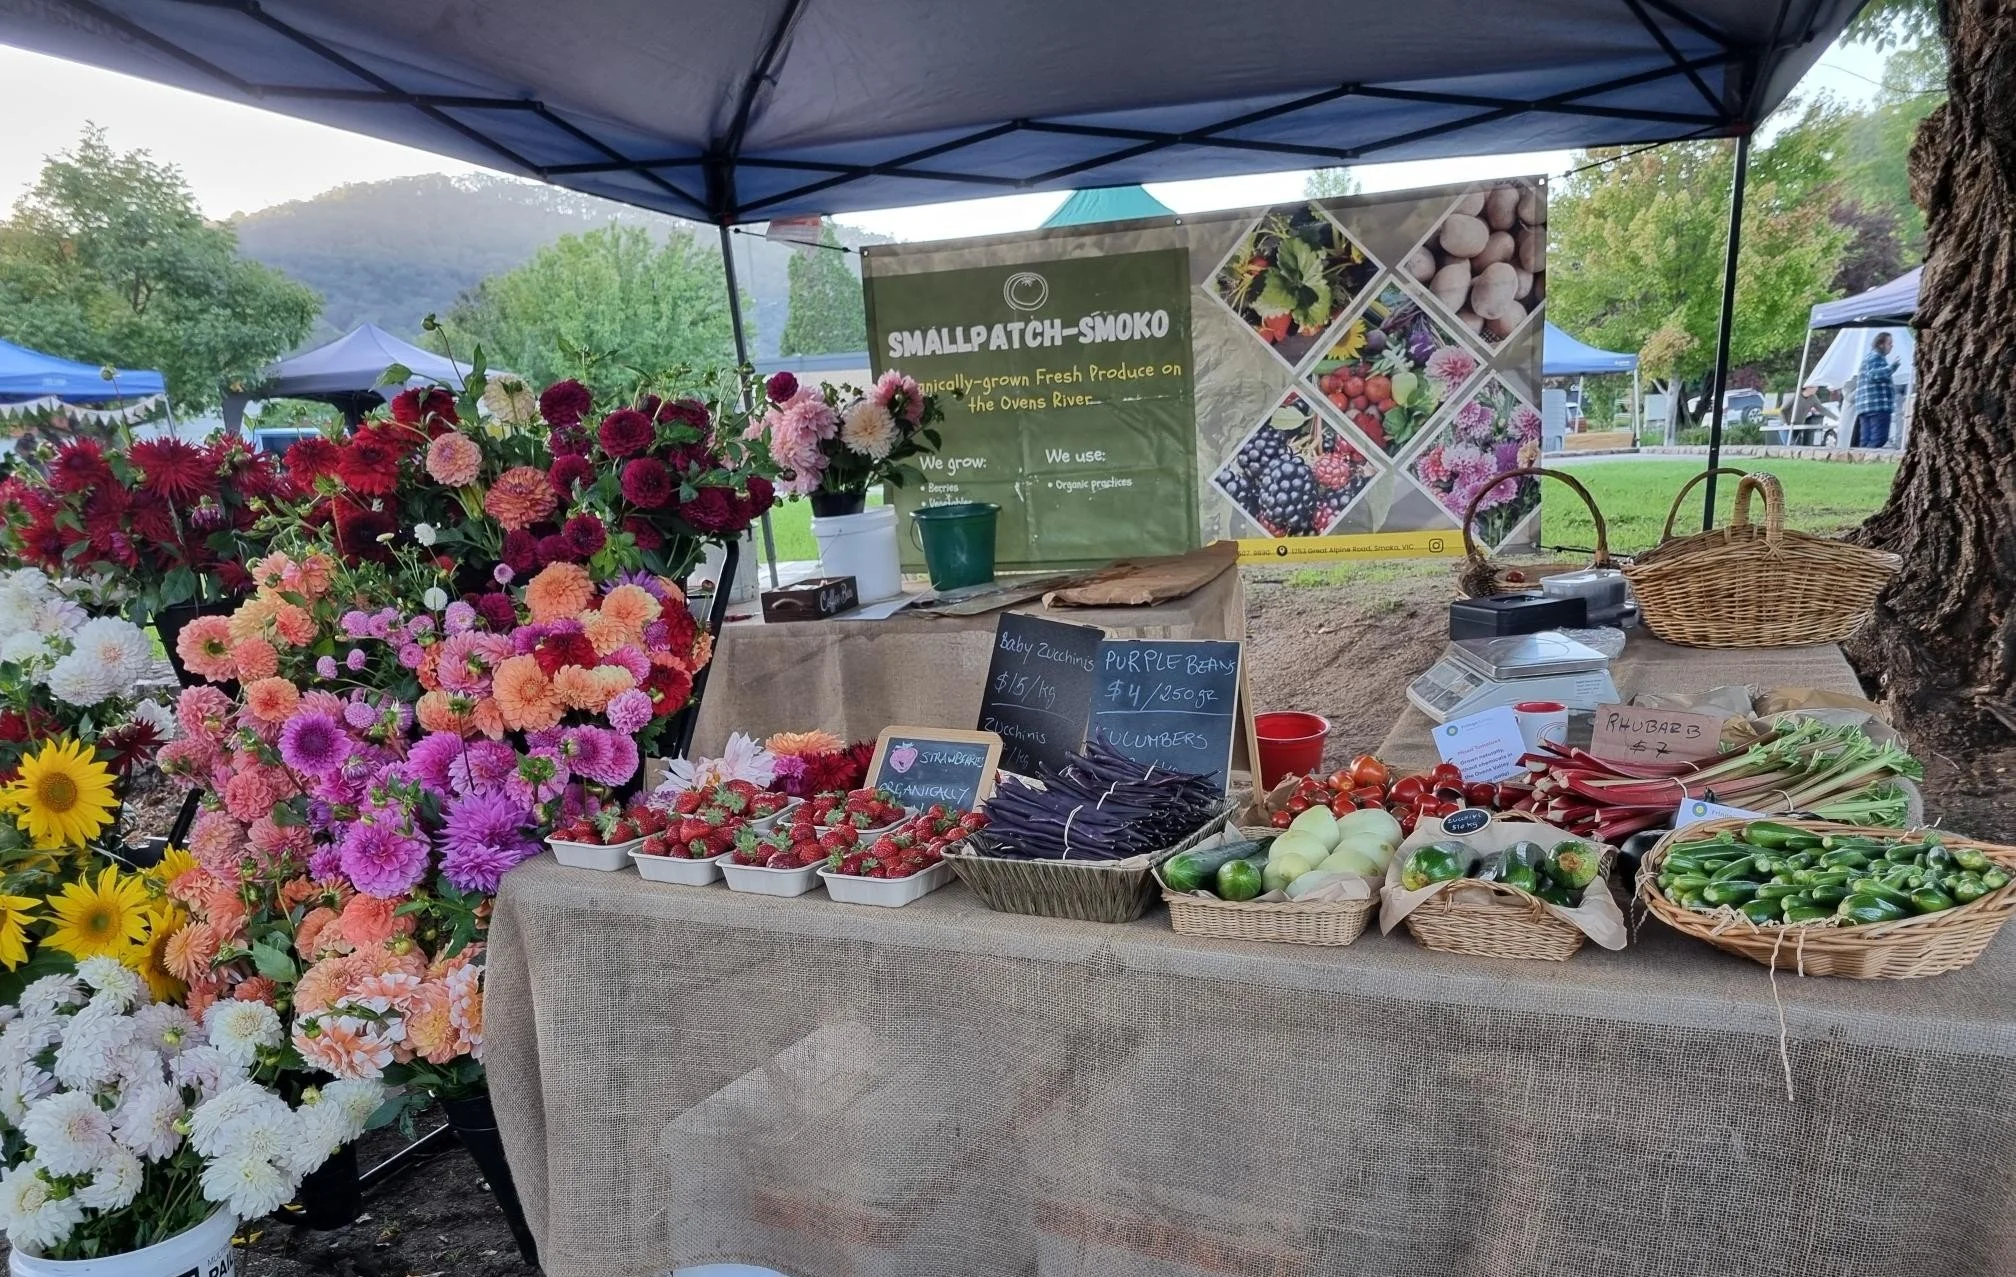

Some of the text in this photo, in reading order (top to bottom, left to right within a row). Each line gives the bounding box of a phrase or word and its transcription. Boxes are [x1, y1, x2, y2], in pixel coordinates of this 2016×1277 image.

[888, 309, 1169, 358] SMALLPATCH-SMOKO
[918, 362, 1181, 397] anically-grown Fresh Produce on
[968, 394, 1093, 414] the Ovens River
[919, 456, 987, 476] We grow:
[1045, 449, 1106, 464] We use:
[1055, 476, 1134, 493] Organic practices
[1000, 631, 1095, 672] Baby Zucchinis
[1105, 650, 1236, 676] PURPLE BEANS
[1605, 712, 1702, 739] RHUBARB
[1103, 727, 1208, 750] UCUMBERS
